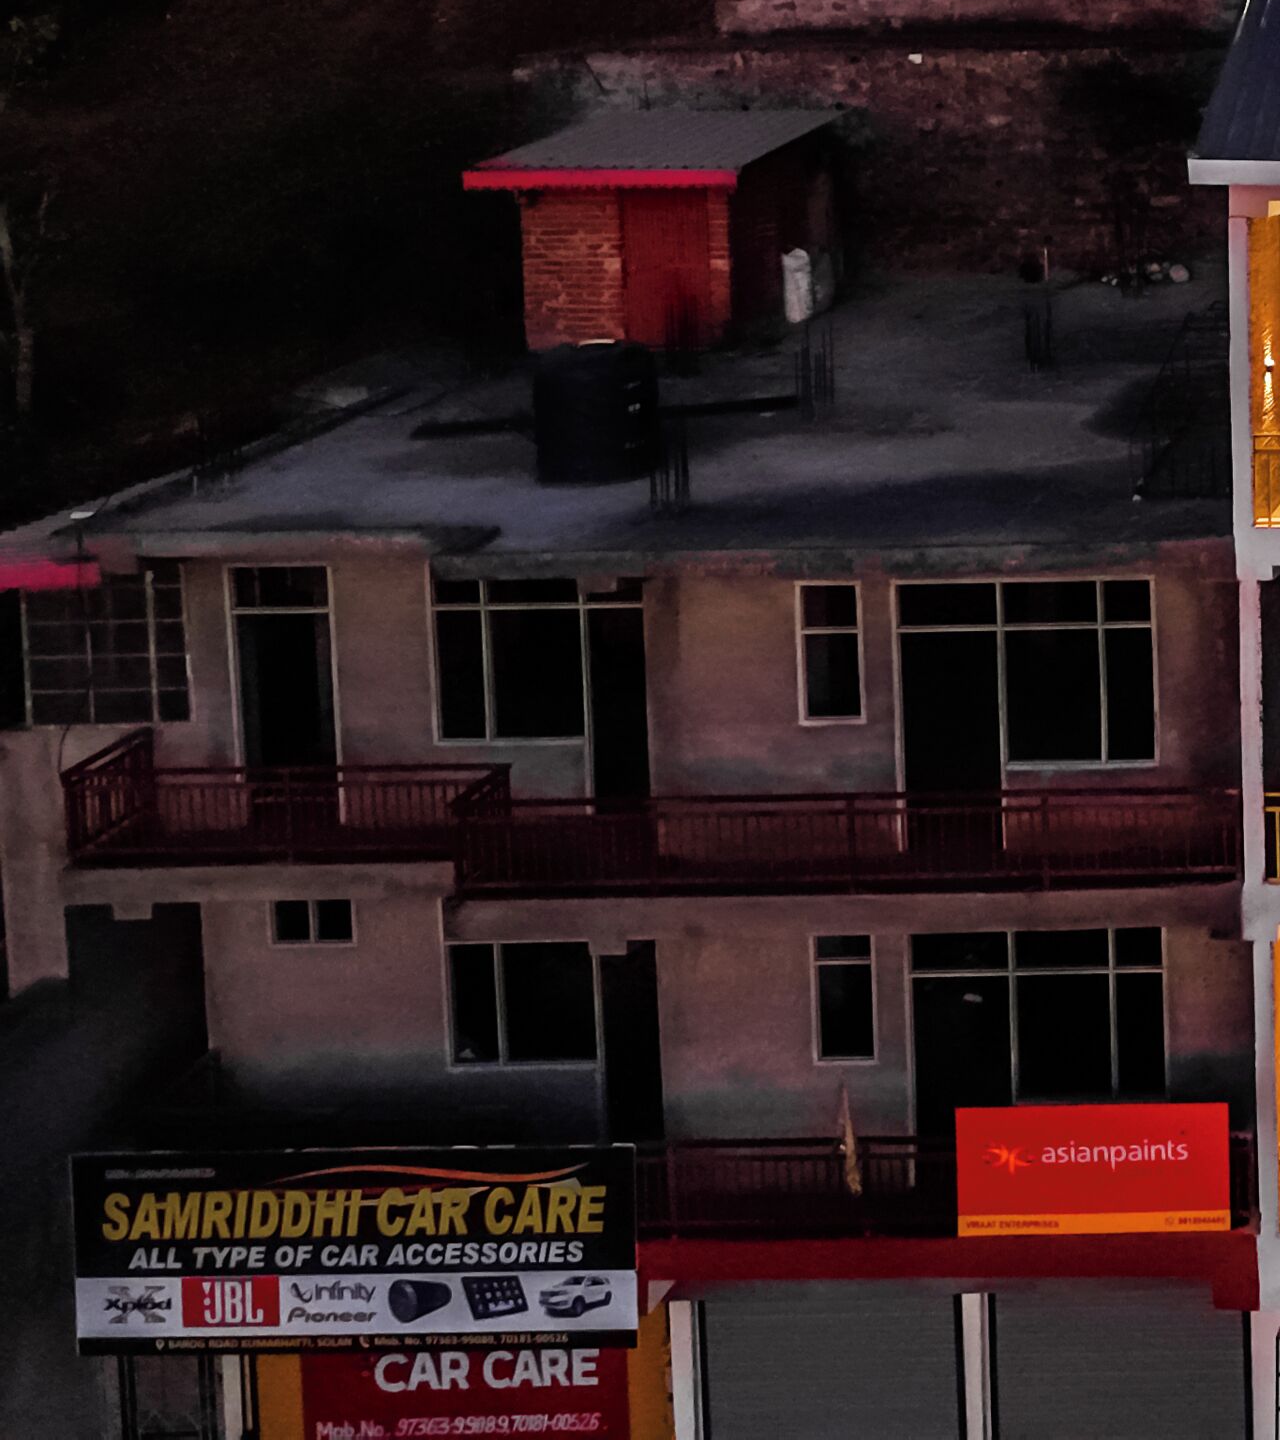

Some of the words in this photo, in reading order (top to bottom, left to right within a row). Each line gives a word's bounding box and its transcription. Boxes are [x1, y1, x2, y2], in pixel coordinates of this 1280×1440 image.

[1041, 1139, 1188, 1172] asianpaints
[102, 1187, 364, 1241] SAMRIDDHI
[376, 1188, 473, 1237] CAR
[484, 1184, 608, 1234] CARE
[128, 1246, 183, 1270] ALL
[194, 1245, 266, 1269] TYPE
[275, 1244, 314, 1268] OF
[320, 1244, 380, 1267] CAR
[386, 1241, 585, 1266] ACCESSORIES
[203, 1281, 265, 1324] JBL
[287, 1307, 378, 1324] Pioneer
[208, 1339, 239, 1349] ROAD
[317, 1338, 353, 1348] SOLAN
[374, 1350, 471, 1393] CAR
[482, 1348, 601, 1389] CARE
